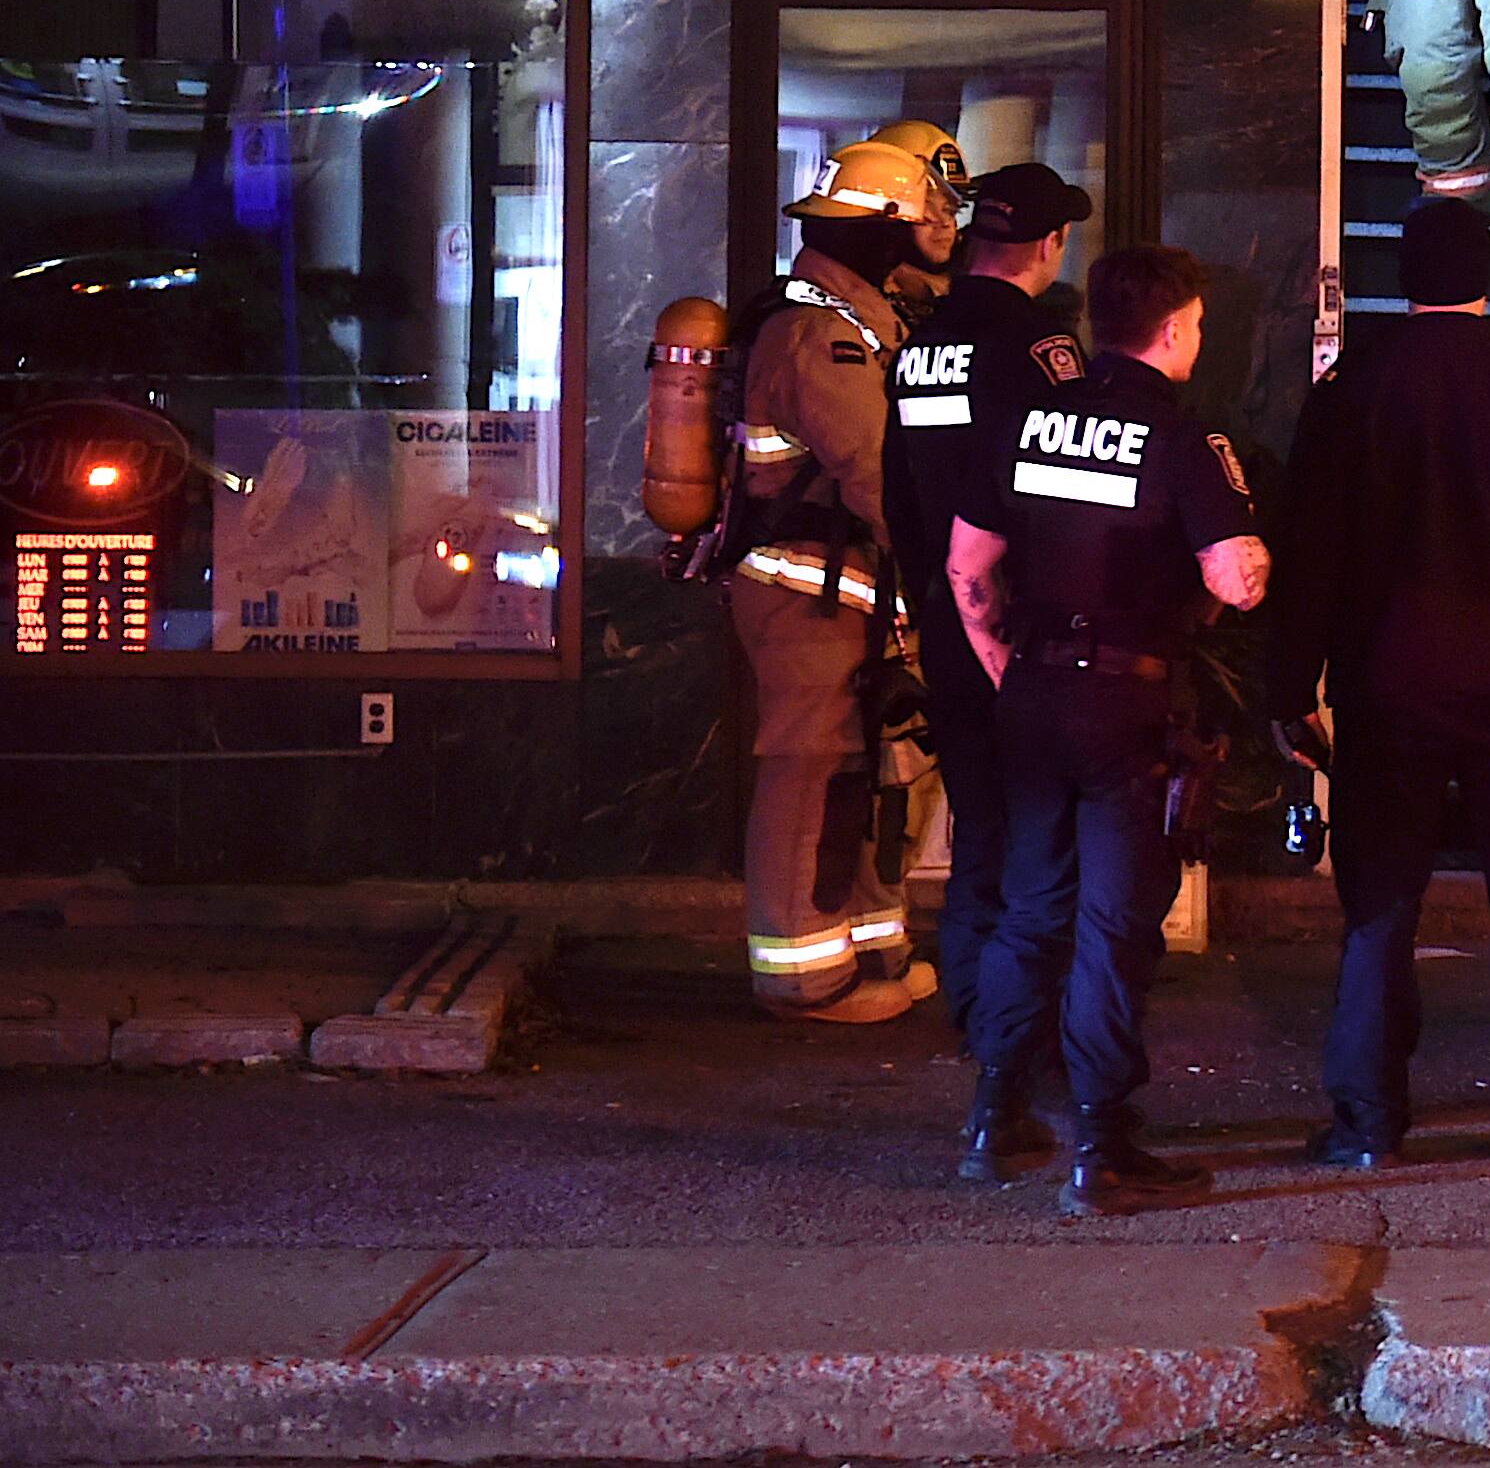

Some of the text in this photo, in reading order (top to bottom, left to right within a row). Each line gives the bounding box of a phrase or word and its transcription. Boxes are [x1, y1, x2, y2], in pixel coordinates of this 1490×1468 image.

[895, 344, 974, 386] POLICE
[396, 421, 537, 443] CICALEINE
[1019, 410, 1150, 465] POLICE
